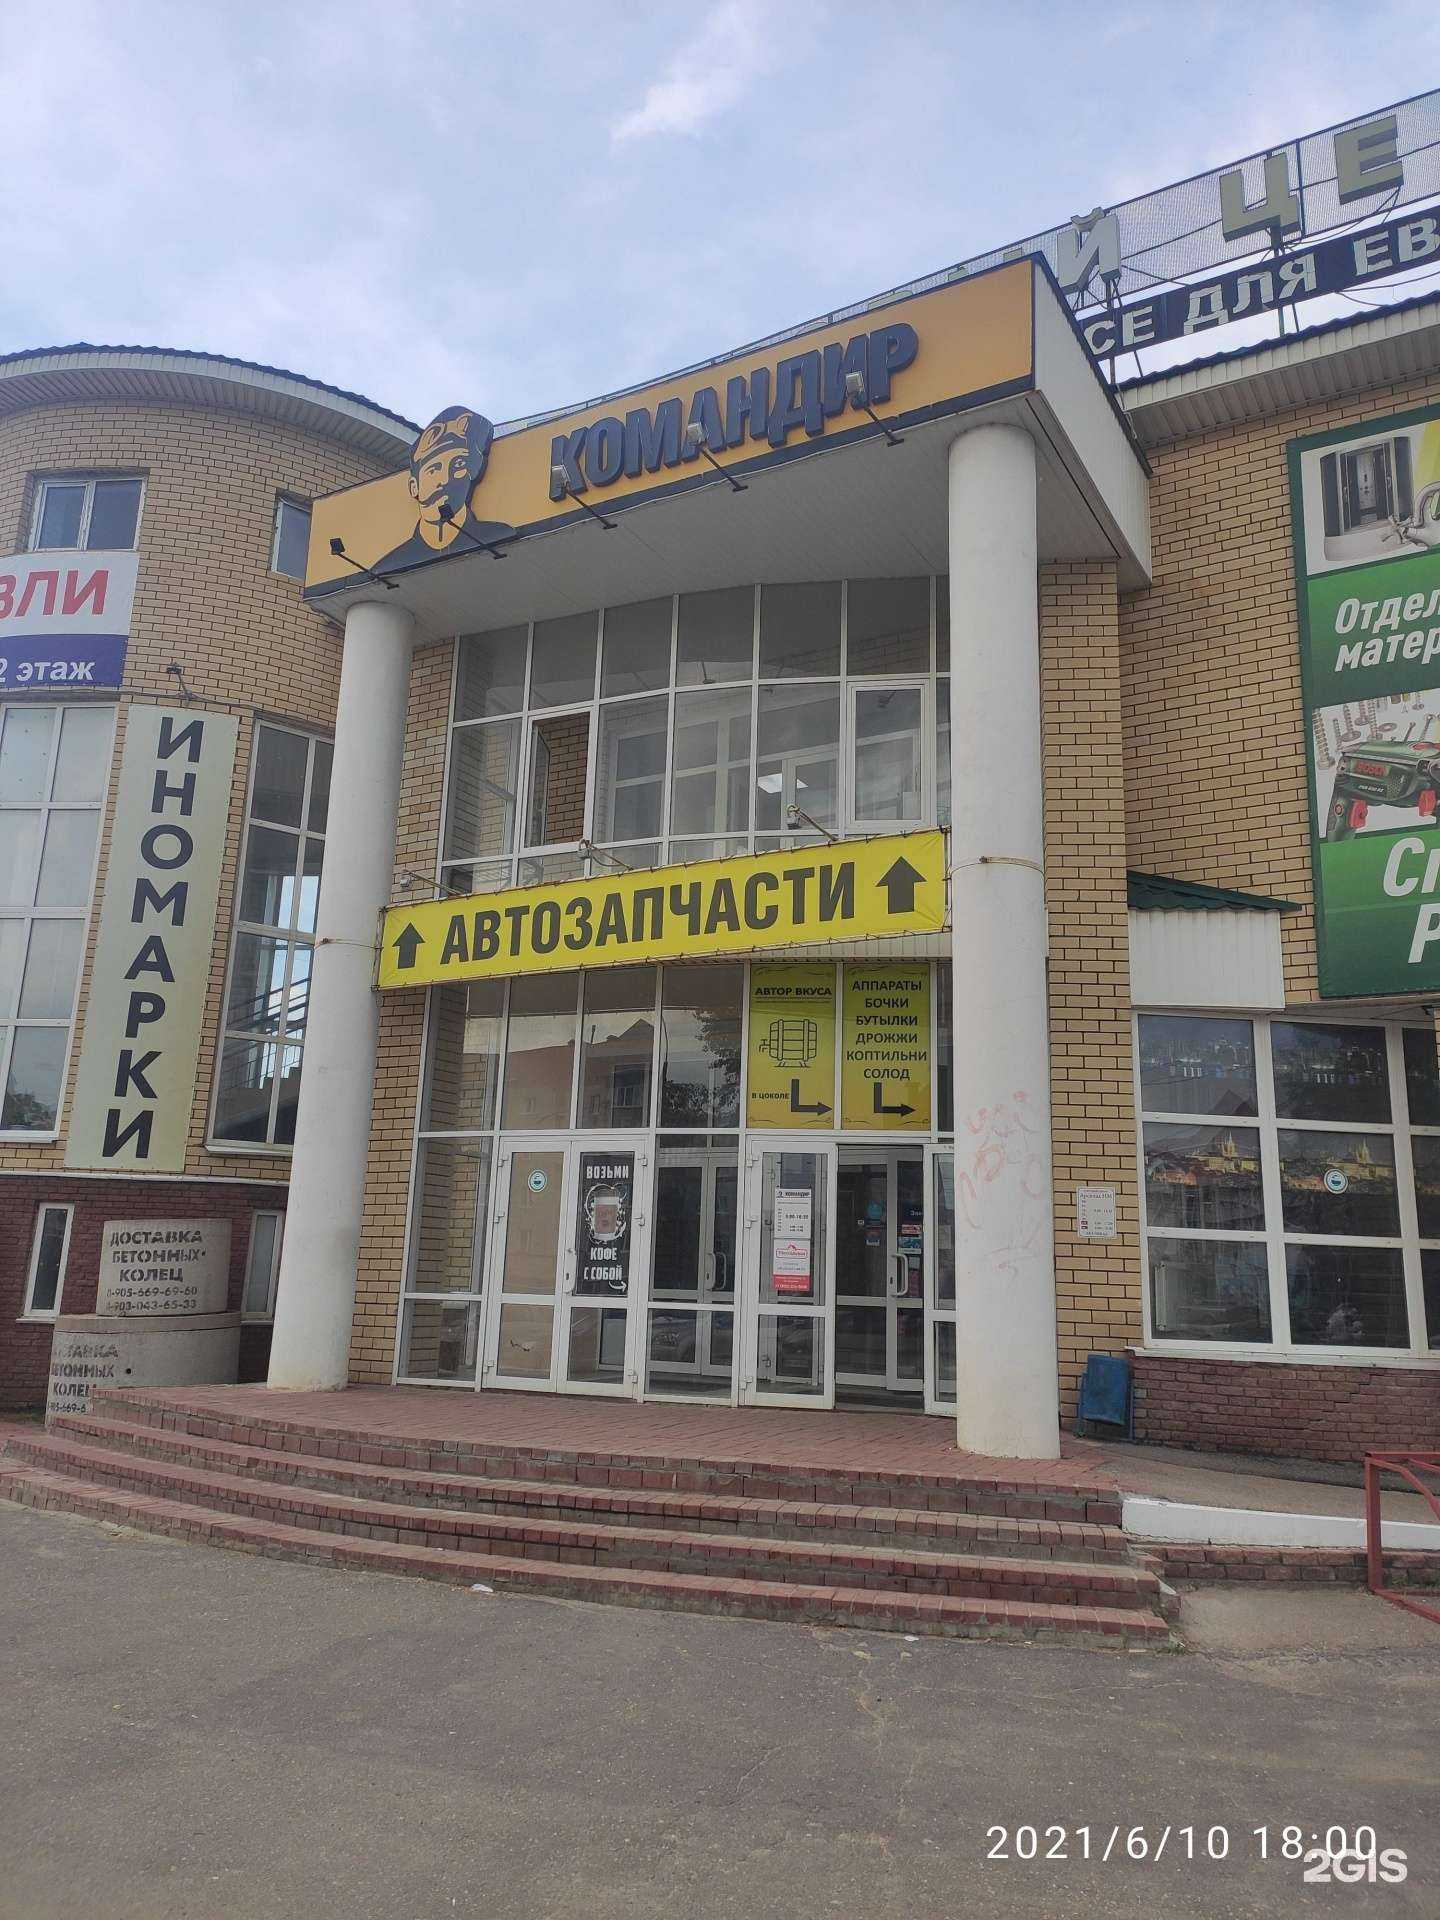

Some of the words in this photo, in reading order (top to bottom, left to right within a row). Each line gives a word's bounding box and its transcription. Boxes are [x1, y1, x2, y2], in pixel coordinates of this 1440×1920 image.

[1183, 253, 1317, 336] ДЛЯ
[549, 322, 919, 501] КОМАНДИР
[16, 660, 95, 682] этаж
[439, 861, 856, 966] АВТОЗАПЧАСТИ
[102, 716, 205, 1160] ИНОМАРКИ
[754, 987, 793, 997] АВТОР
[795, 986, 832, 997] ВКУСА
[852, 980, 922, 992] АППАРАТЫ
[865, 998, 909, 1009] БОЧКИ
[856, 1015, 918, 1027] БУТЫЛКИ
[855, 1033, 918, 1045] ДРОЖЖИ
[846, 1050, 928, 1061] КОПТИЛЬНИ
[863, 1068, 911, 1081] СОЛОД
[586, 1165, 629, 1179] ВОЗЬМИ
[110, 1230, 203, 1247] ДОСТАВКА
[112, 1249, 200, 1264] БЕТОННЫХ
[590, 1247, 617, 1261] КОФЕ
[119, 1268, 184, 1282] КОЛЕЦ
[583, 1267, 589, 1280] С
[590, 1264, 622, 1281] СОБОЙ
